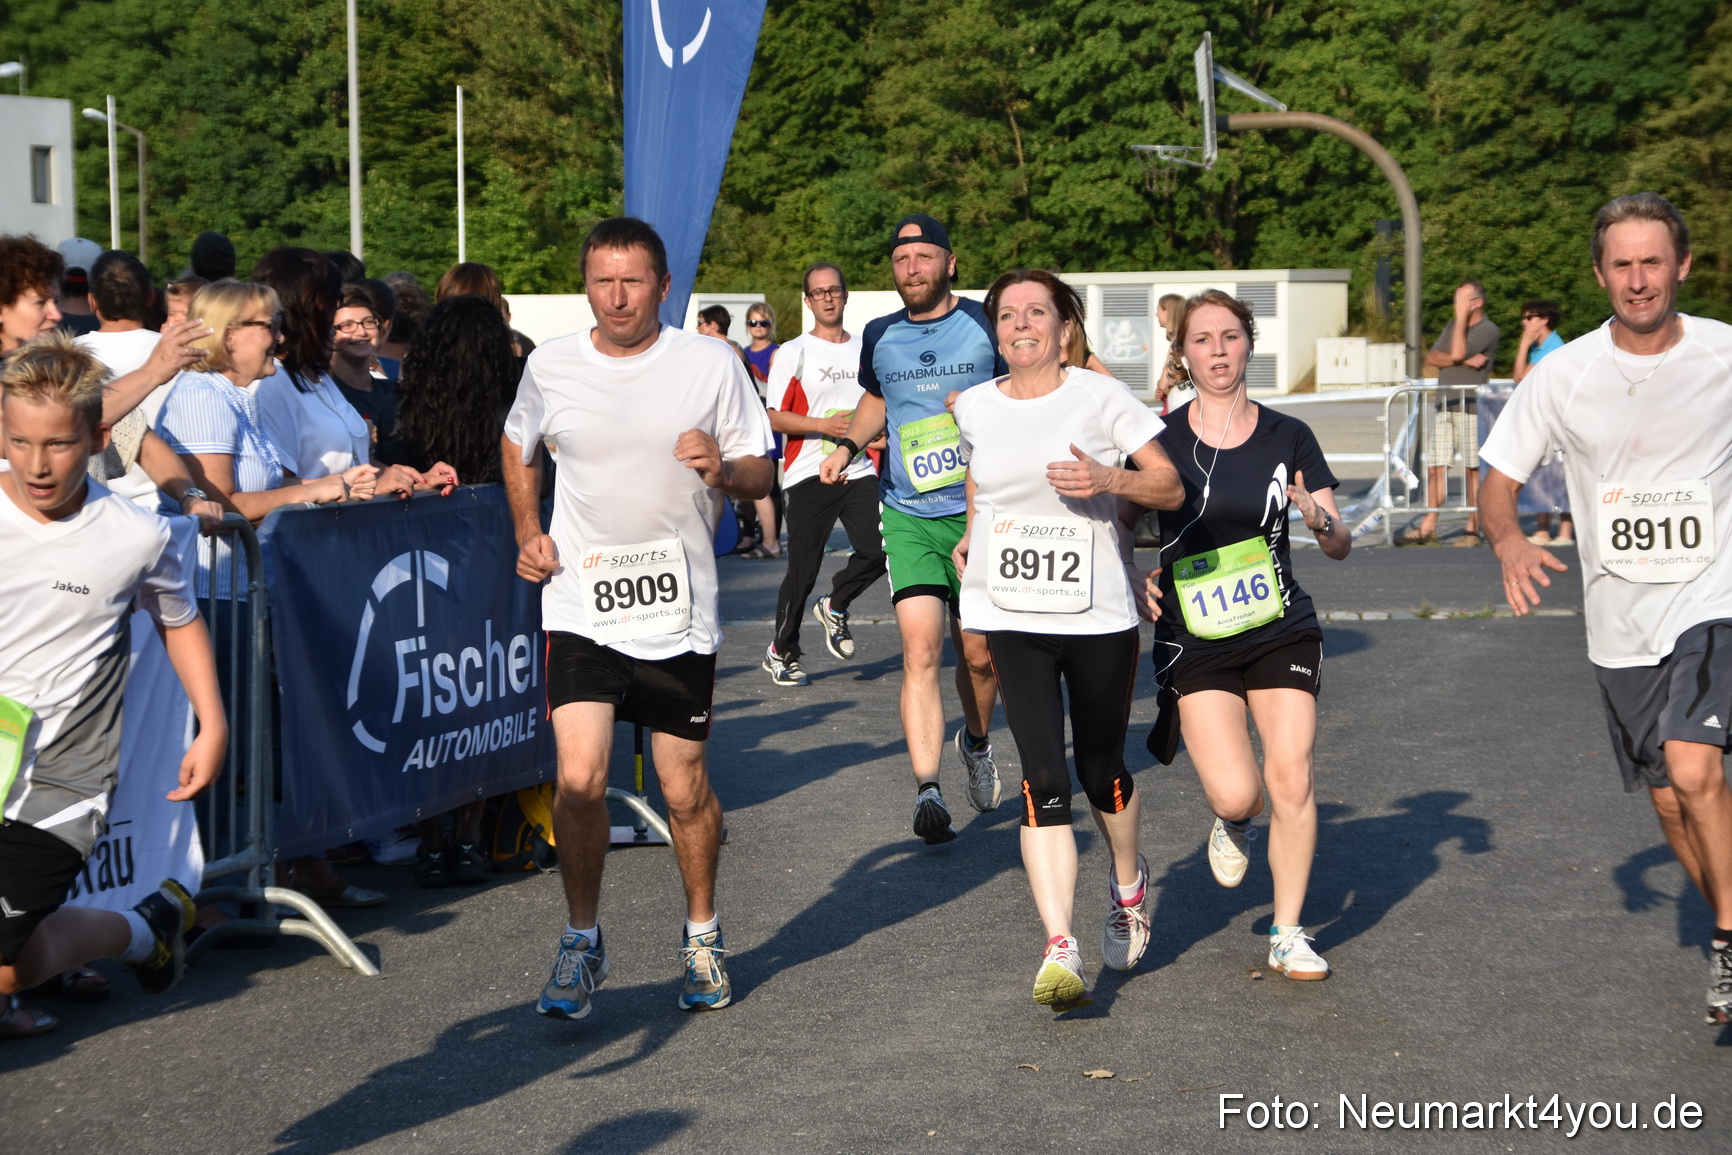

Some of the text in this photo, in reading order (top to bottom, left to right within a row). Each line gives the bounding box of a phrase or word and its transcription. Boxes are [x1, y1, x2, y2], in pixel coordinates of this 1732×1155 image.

[818, 366, 859, 384] Xplu
[885, 363, 975, 384] SCHABMÜLLER
[916, 383, 940, 392] TEAM
[898, 491, 966, 505] www.schabmuel
[1602, 488, 1695, 506] df-sports
[994, 519, 1077, 537] df-sports
[1611, 515, 1702, 551] 8910
[582, 550, 668, 569] df-sports
[1000, 547, 1080, 583] 8912
[1605, 554, 1711, 567] www.df-sports.de
[52, 580, 90, 595] Jakob
[593, 572, 678, 613] 8909
[992, 585, 1087, 598] www.df-sports.de
[1191, 573, 1270, 617] 1146
[592, 607, 688, 628] www.df-sports.de
[1217, 618, 1233, 626] Anna
[1290, 664, 1312, 676] JAKO
[402, 707, 537, 773] AUTOMOBILE
